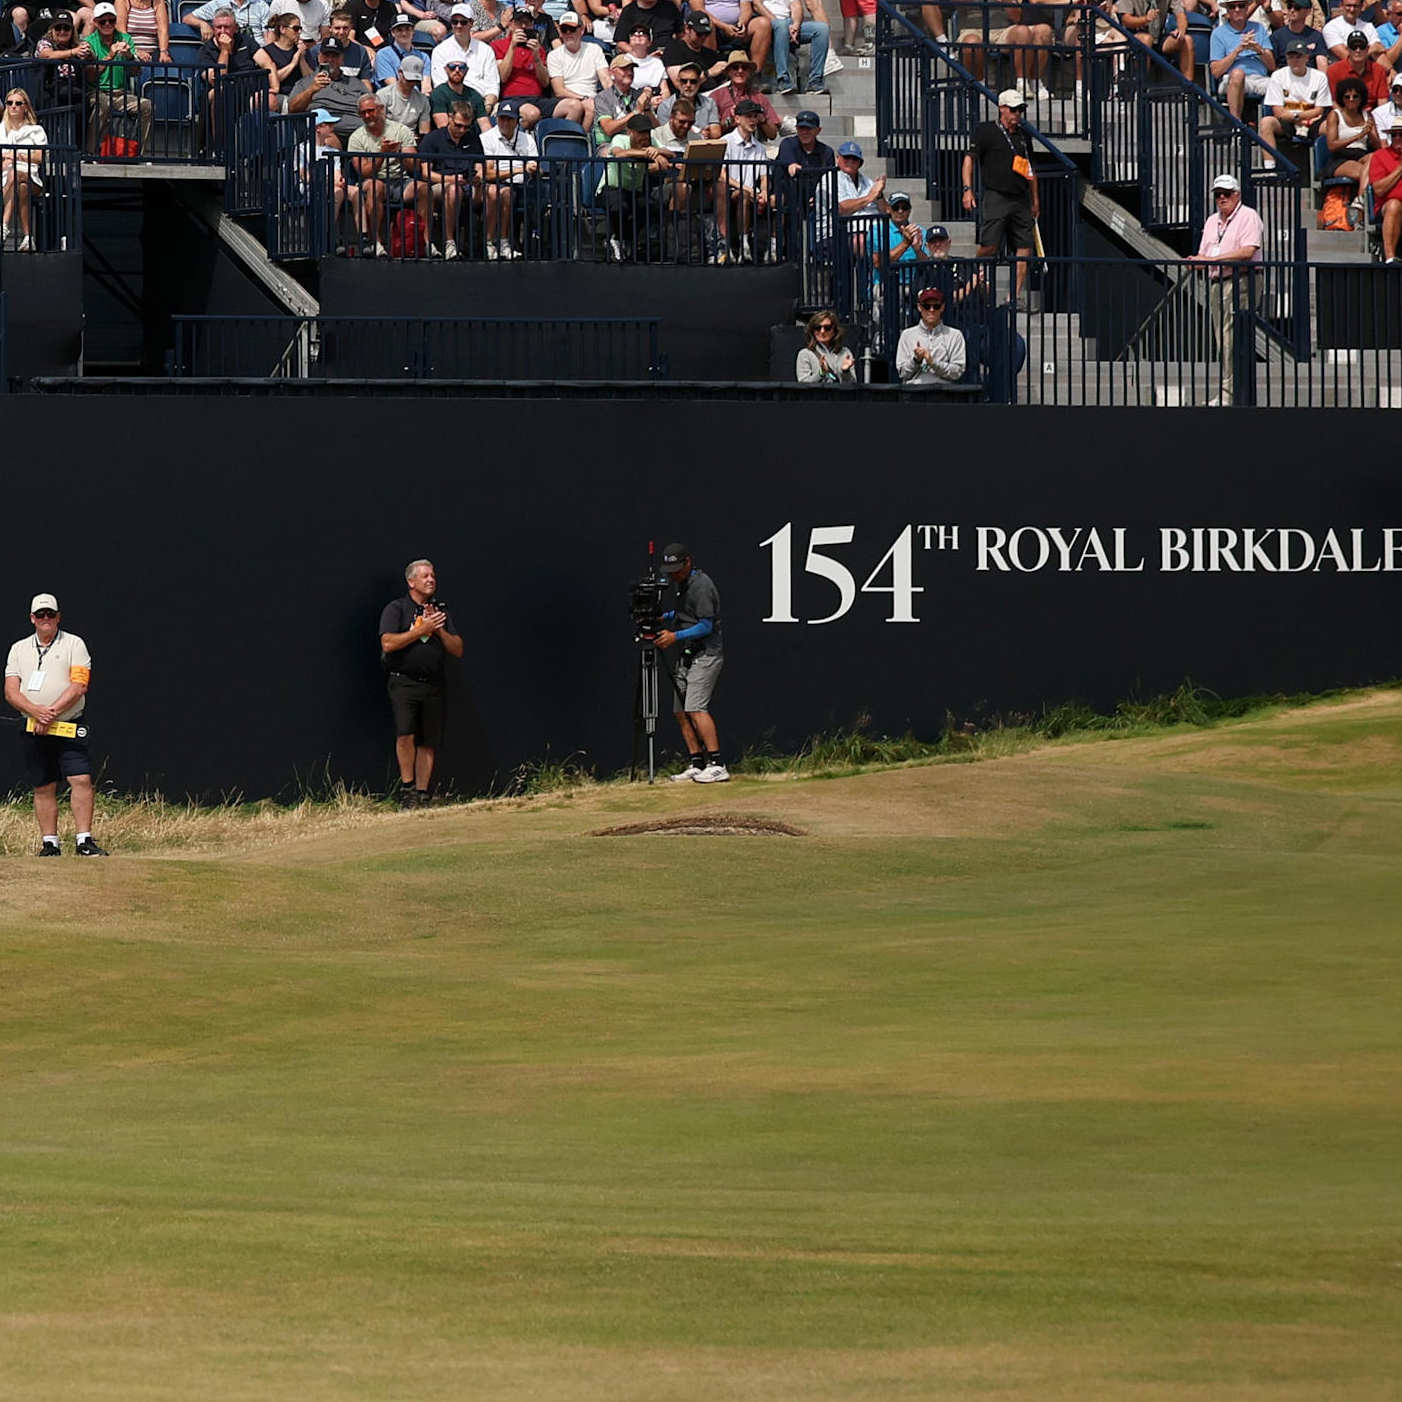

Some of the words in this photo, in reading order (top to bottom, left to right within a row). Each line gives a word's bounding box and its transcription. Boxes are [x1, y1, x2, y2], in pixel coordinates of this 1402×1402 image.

[760, 523, 958, 624] 154TH
[976, 527, 1144, 572] ROYAL
[1160, 528, 1402, 571] BIRKDALE
